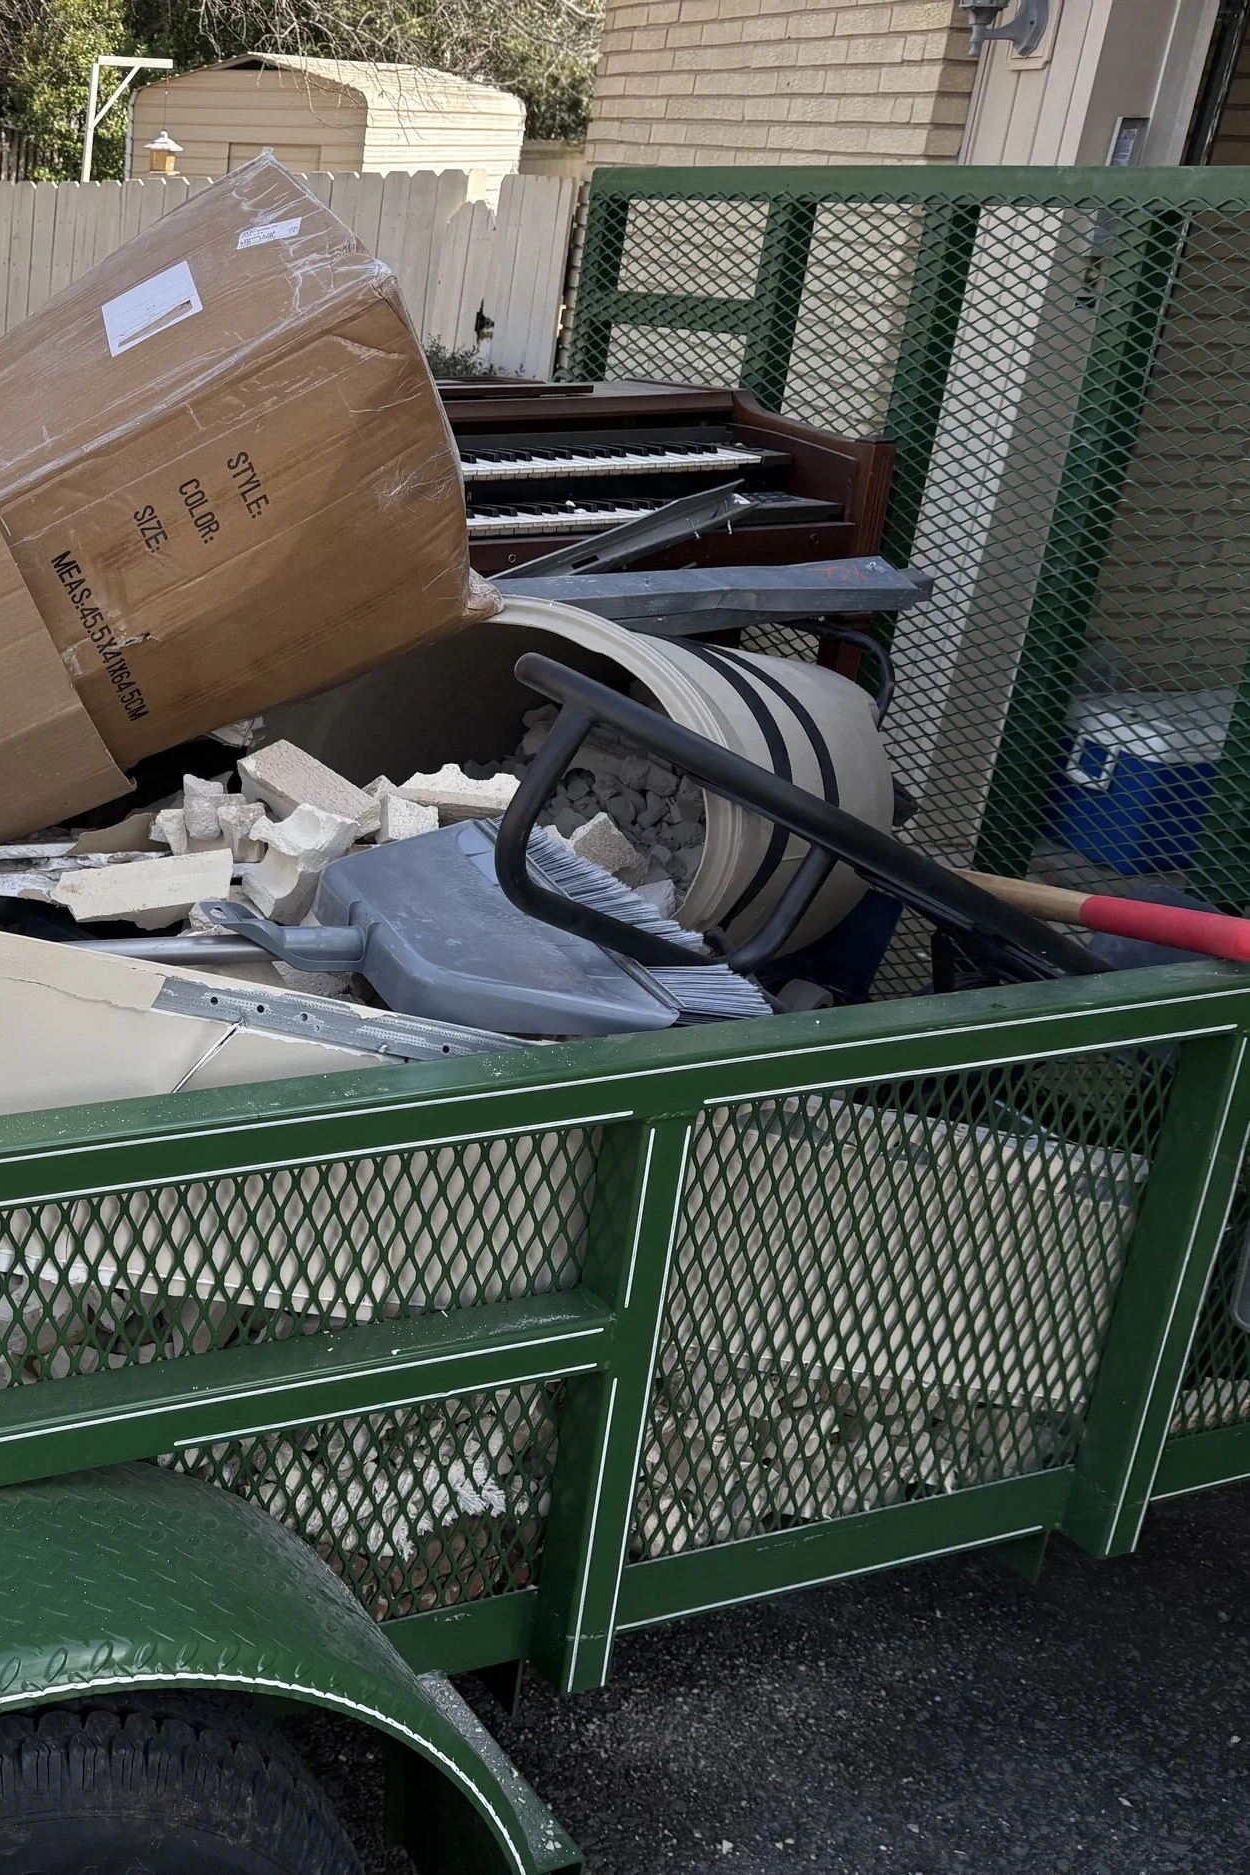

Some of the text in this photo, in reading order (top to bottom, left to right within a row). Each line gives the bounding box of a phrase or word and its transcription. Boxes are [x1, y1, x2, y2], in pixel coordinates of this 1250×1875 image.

[178, 478, 221, 544] COLOR:
[227, 451, 270, 519] STYLE:
[133, 504, 169, 553] SIZE:
